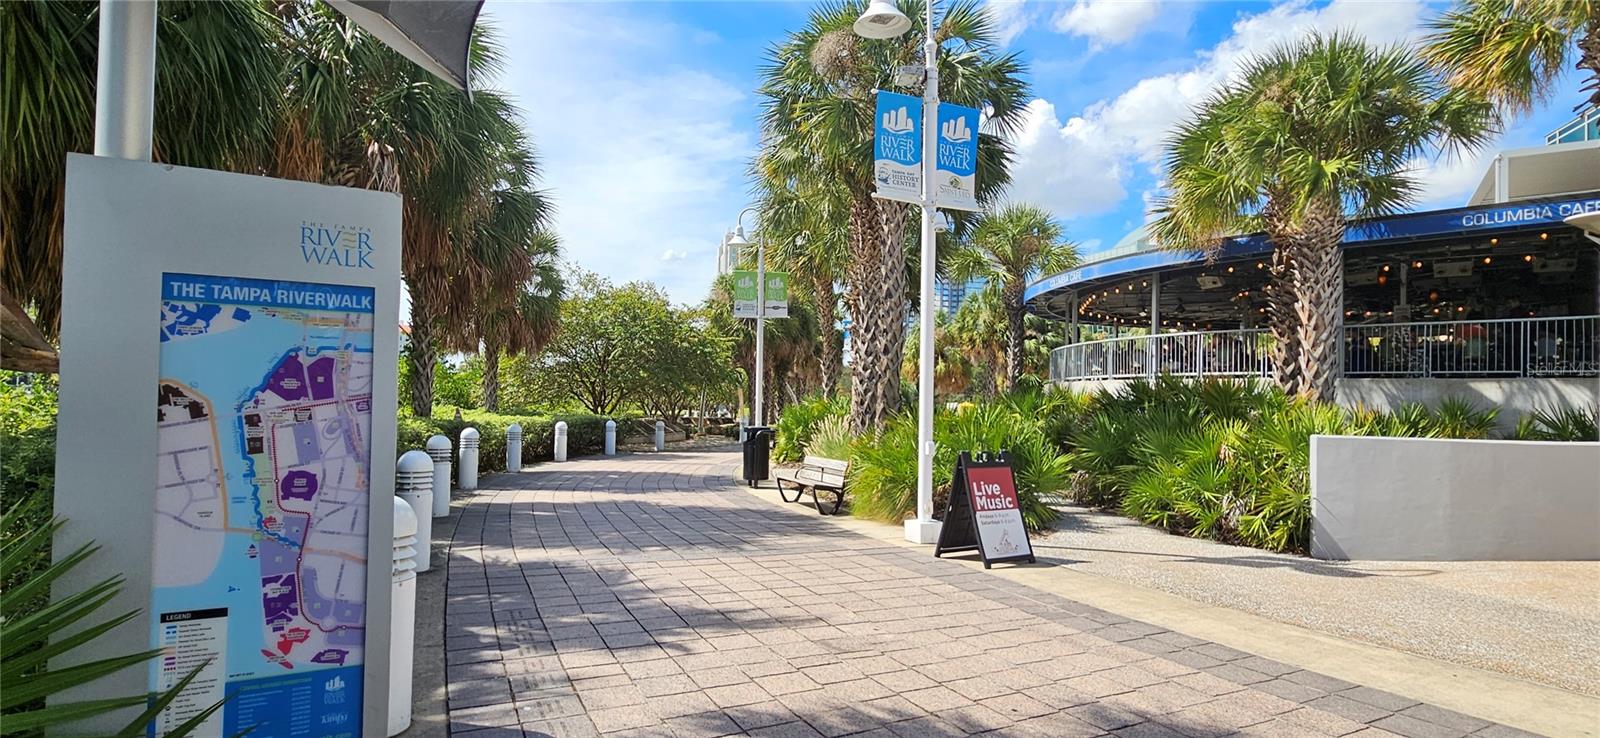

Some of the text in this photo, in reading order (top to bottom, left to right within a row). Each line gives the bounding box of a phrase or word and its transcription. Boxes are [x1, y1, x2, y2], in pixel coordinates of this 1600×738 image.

[881, 135, 914, 150] RIVER
[881, 146, 915, 162] WALK
[939, 143, 970, 159] RIVER
[939, 154, 970, 170] WALK
[892, 173, 919, 182] HISTORY
[1462, 206, 1552, 226] COLUMBIA
[301, 226, 373, 251] RIVER
[301, 245, 374, 269] WALK
[170, 281, 371, 309] THE TAMPA RIVERWALK
[972, 481, 1001, 495] Live
[976, 494, 1014, 510] Music
[166, 613, 192, 621] LEGEND
